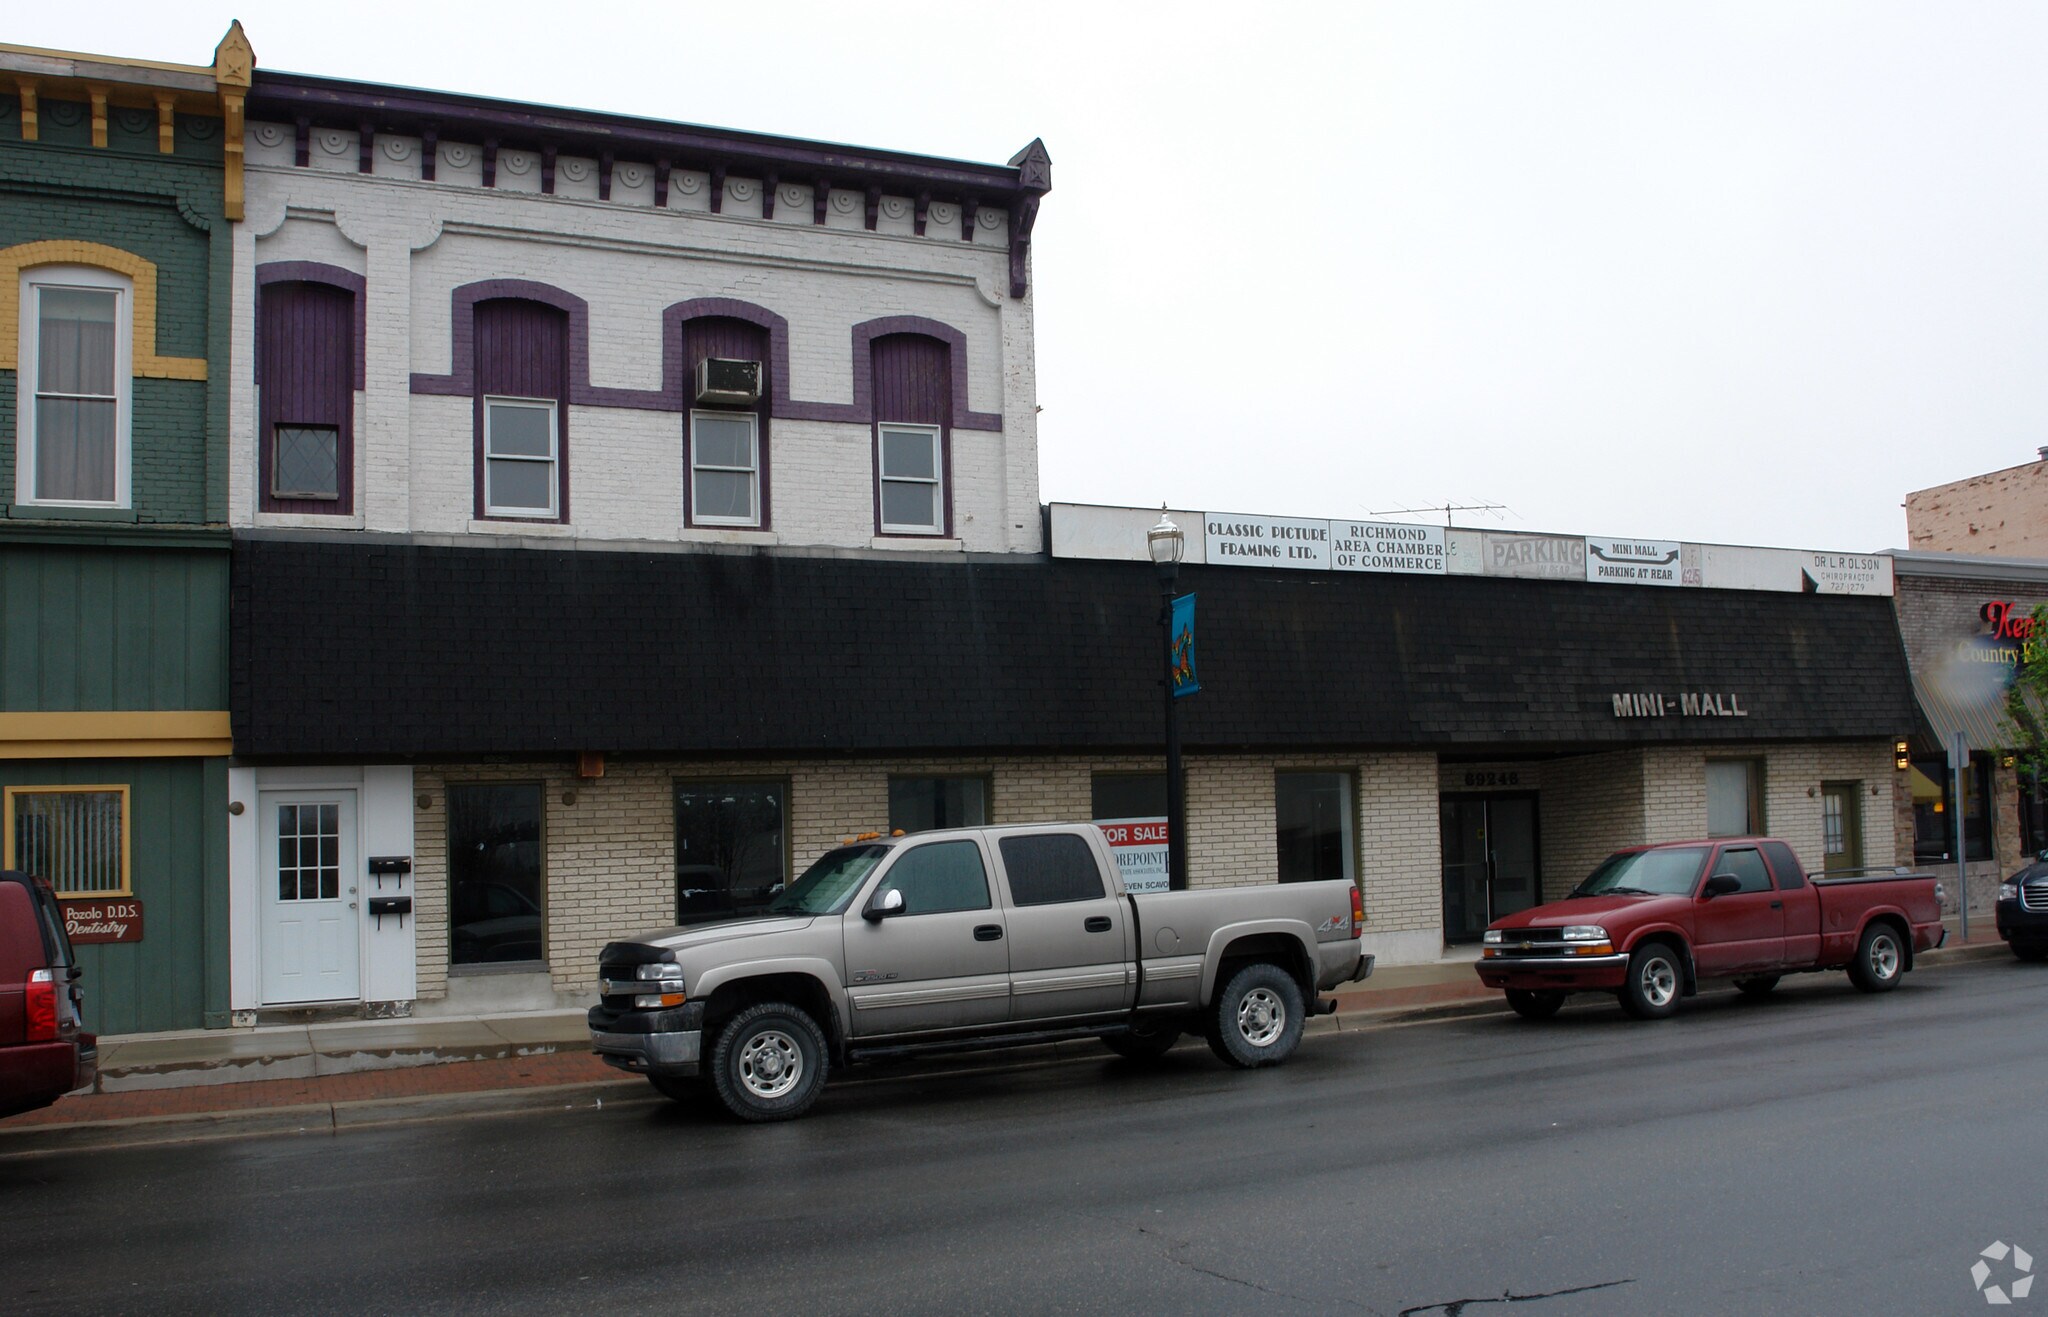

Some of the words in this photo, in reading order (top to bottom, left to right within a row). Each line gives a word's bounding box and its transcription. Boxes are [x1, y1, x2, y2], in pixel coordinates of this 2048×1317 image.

[1208, 522, 1264, 537] CLASSIC
[1271, 526, 1327, 541] PICTURE
[1350, 525, 1427, 541] RICHMOND
[1220, 542, 1281, 558] FRAMING
[1288, 546, 1317, 560] LTD.
[1334, 540, 1371, 552] AREA
[1376, 541, 1443, 556] CHAMBER
[1492, 541, 1583, 568] PARKING
[1612, 544, 1632, 555] MINI
[1634, 545, 1658, 556] MALL
[1337, 555, 1356, 566] OF
[1362, 555, 1442, 570] COMMERCE
[1848, 558, 1880, 570] OLSON
[1598, 566, 1635, 578] PARKING
[1637, 568, 1648, 579] AT
[1650, 569, 1673, 580] REAR
[1821, 572, 1875, 582] CHIROPRACTOR
[1133, 826, 1168, 841] SALE
[66, 907, 102, 920] Pozolo
[107, 904, 139, 918] D.D.S.
[66, 920, 128, 938] Dentistry
